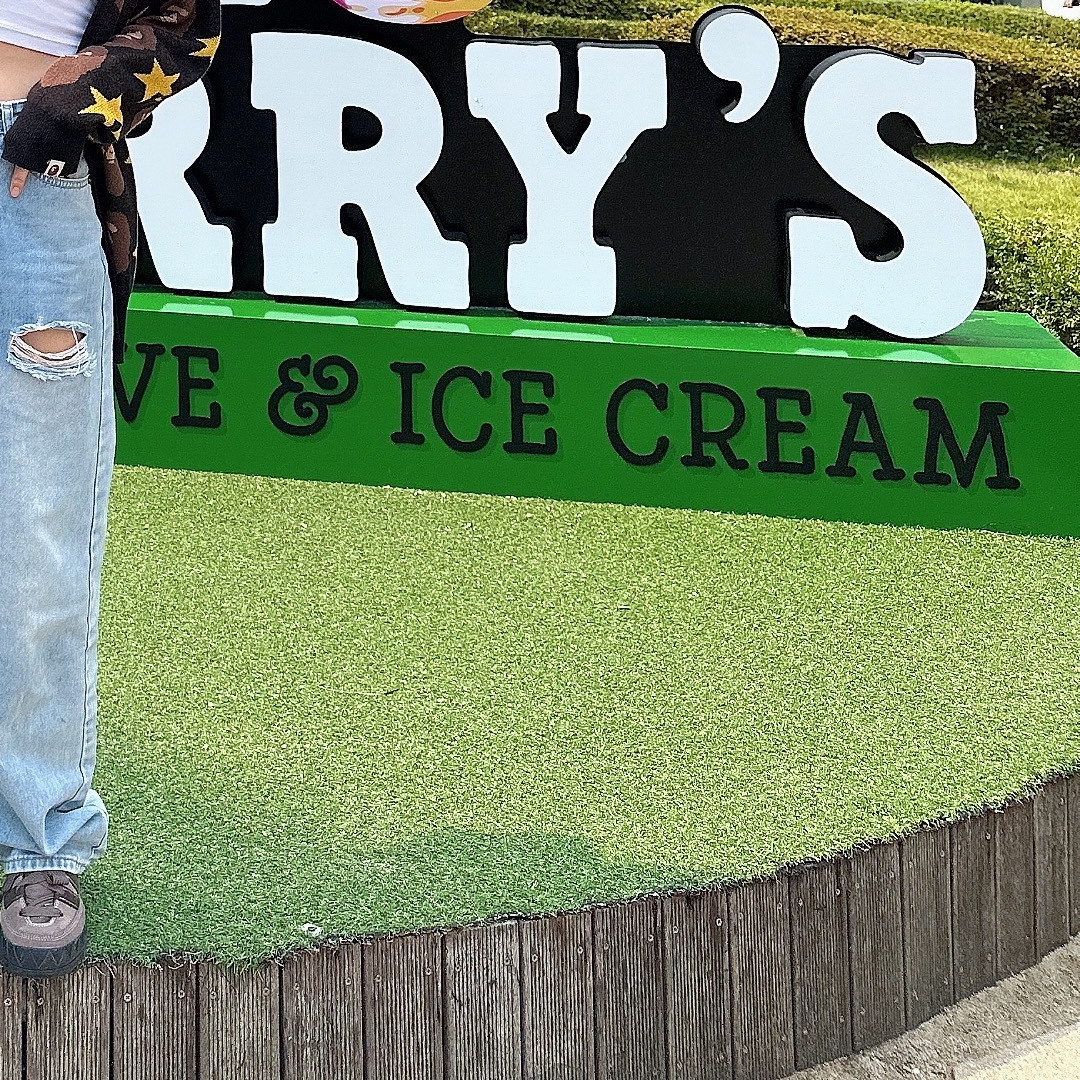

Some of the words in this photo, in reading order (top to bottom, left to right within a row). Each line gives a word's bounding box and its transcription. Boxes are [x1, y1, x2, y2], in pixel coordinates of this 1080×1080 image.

[267, 353, 360, 437] &
[390, 361, 559, 456] ICE
[606, 377, 1022, 491] CREAM
